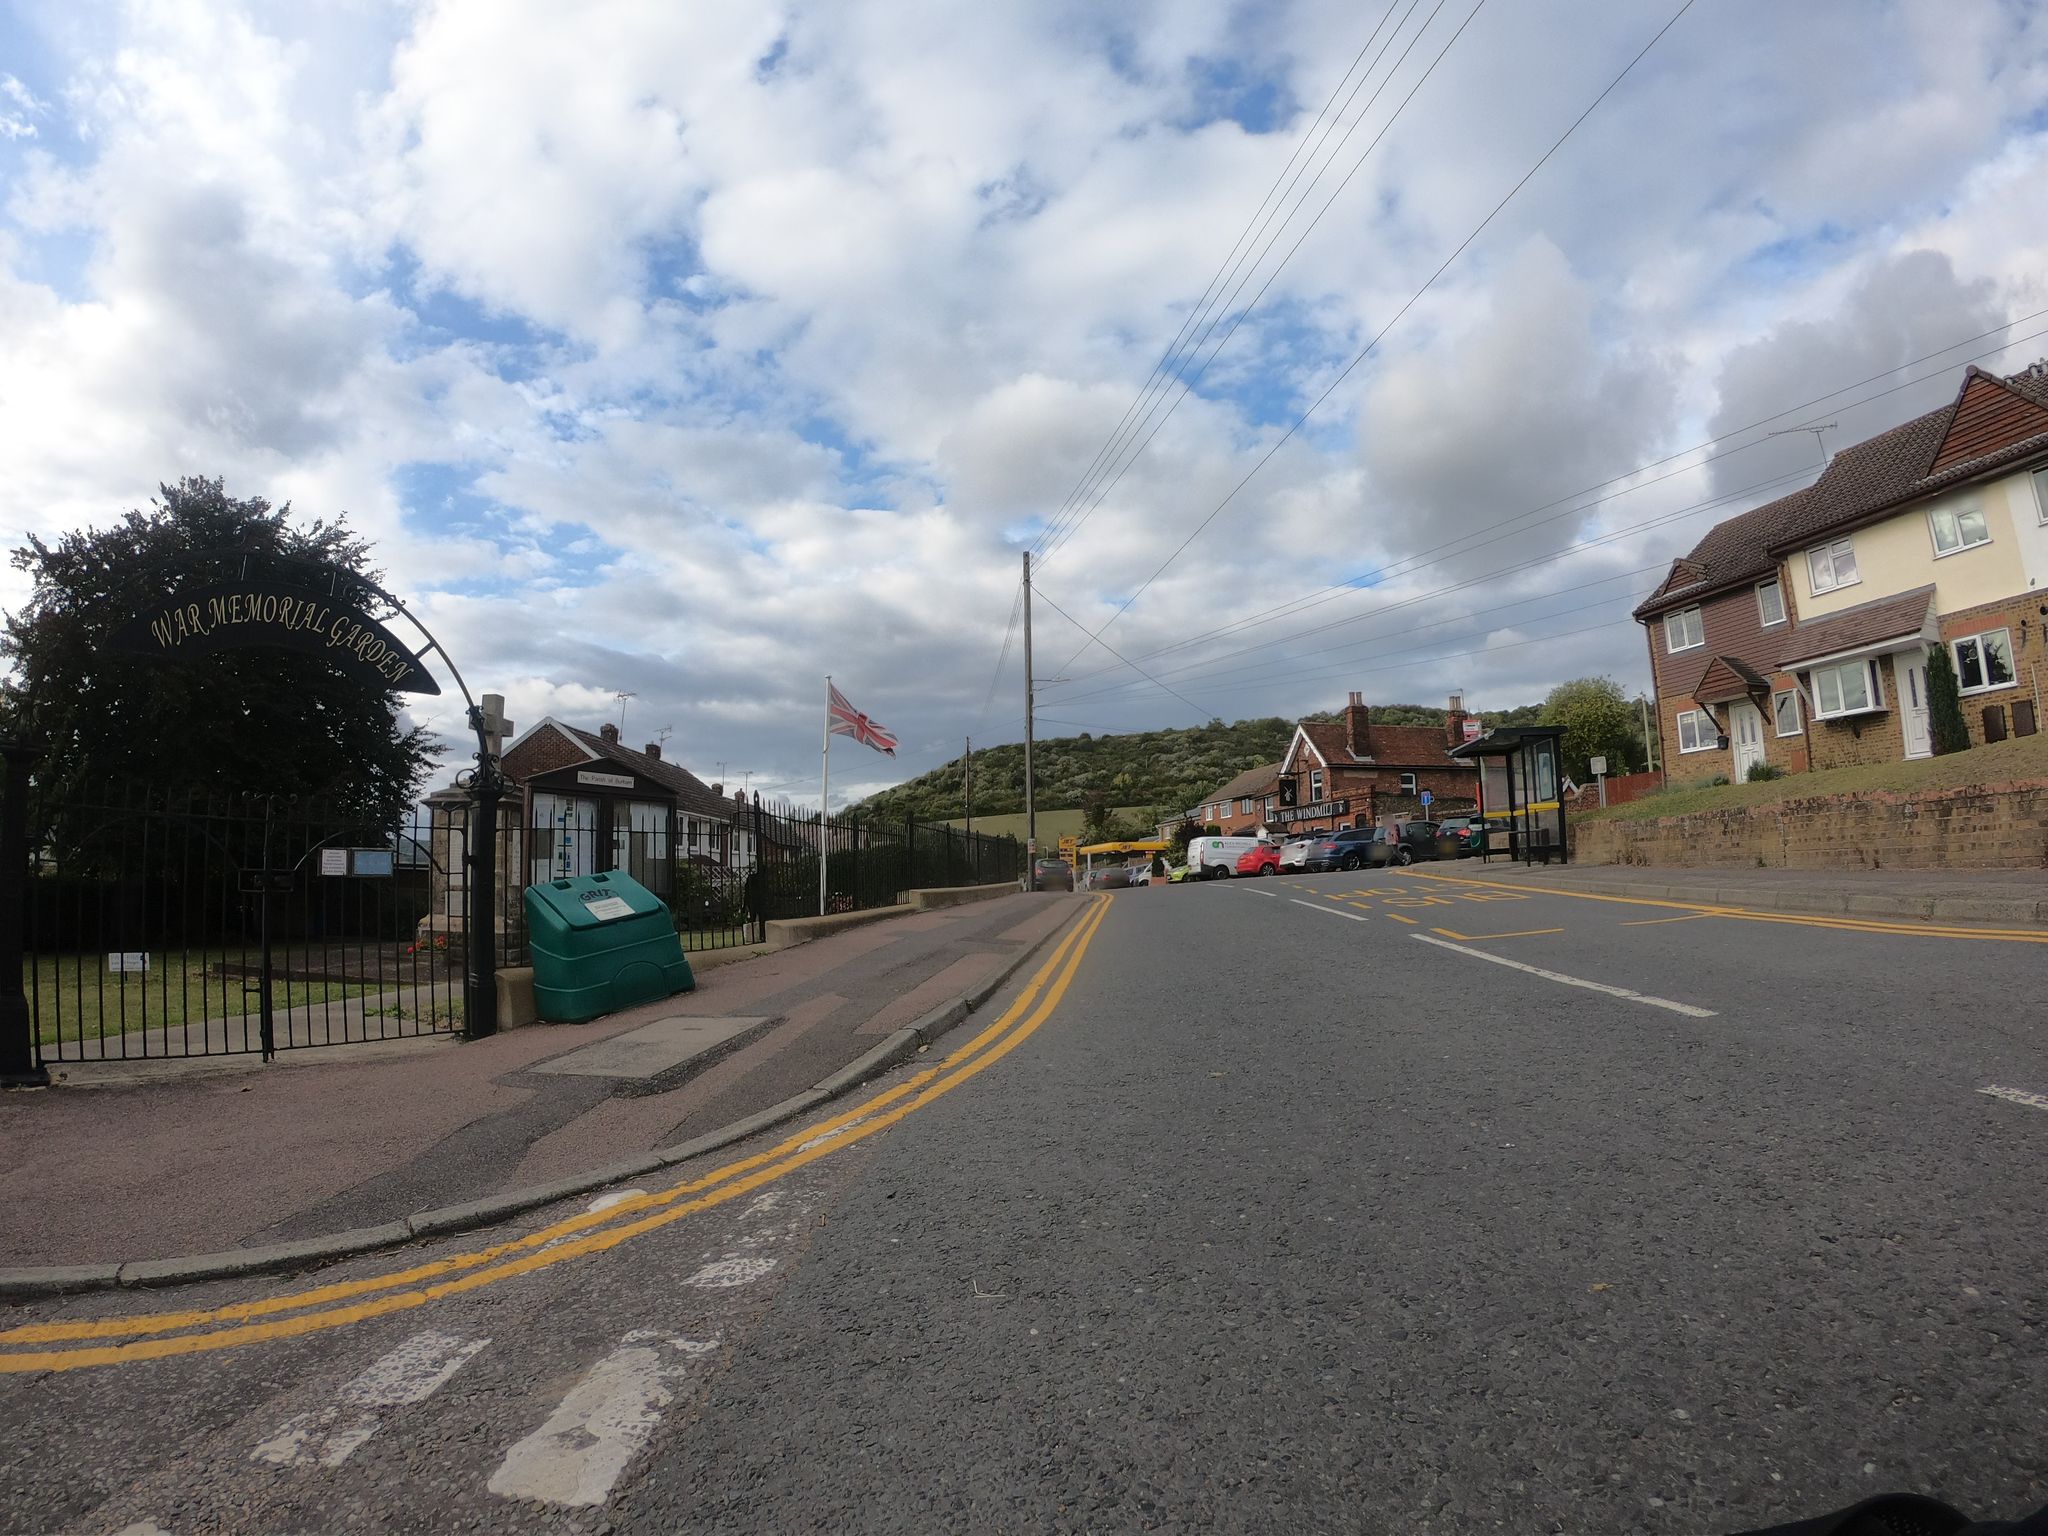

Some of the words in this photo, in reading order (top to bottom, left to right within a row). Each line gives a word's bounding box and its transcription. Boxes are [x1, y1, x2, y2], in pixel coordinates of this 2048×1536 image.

[151, 603, 209, 648] WAR
[208, 593, 331, 634] MEMORIAL
[325, 616, 414, 683] GARDEN
[1280, 811, 1295, 823] THE
[1296, 803, 1332, 820] WINDMILL
[580, 889, 610, 900] GRIT
